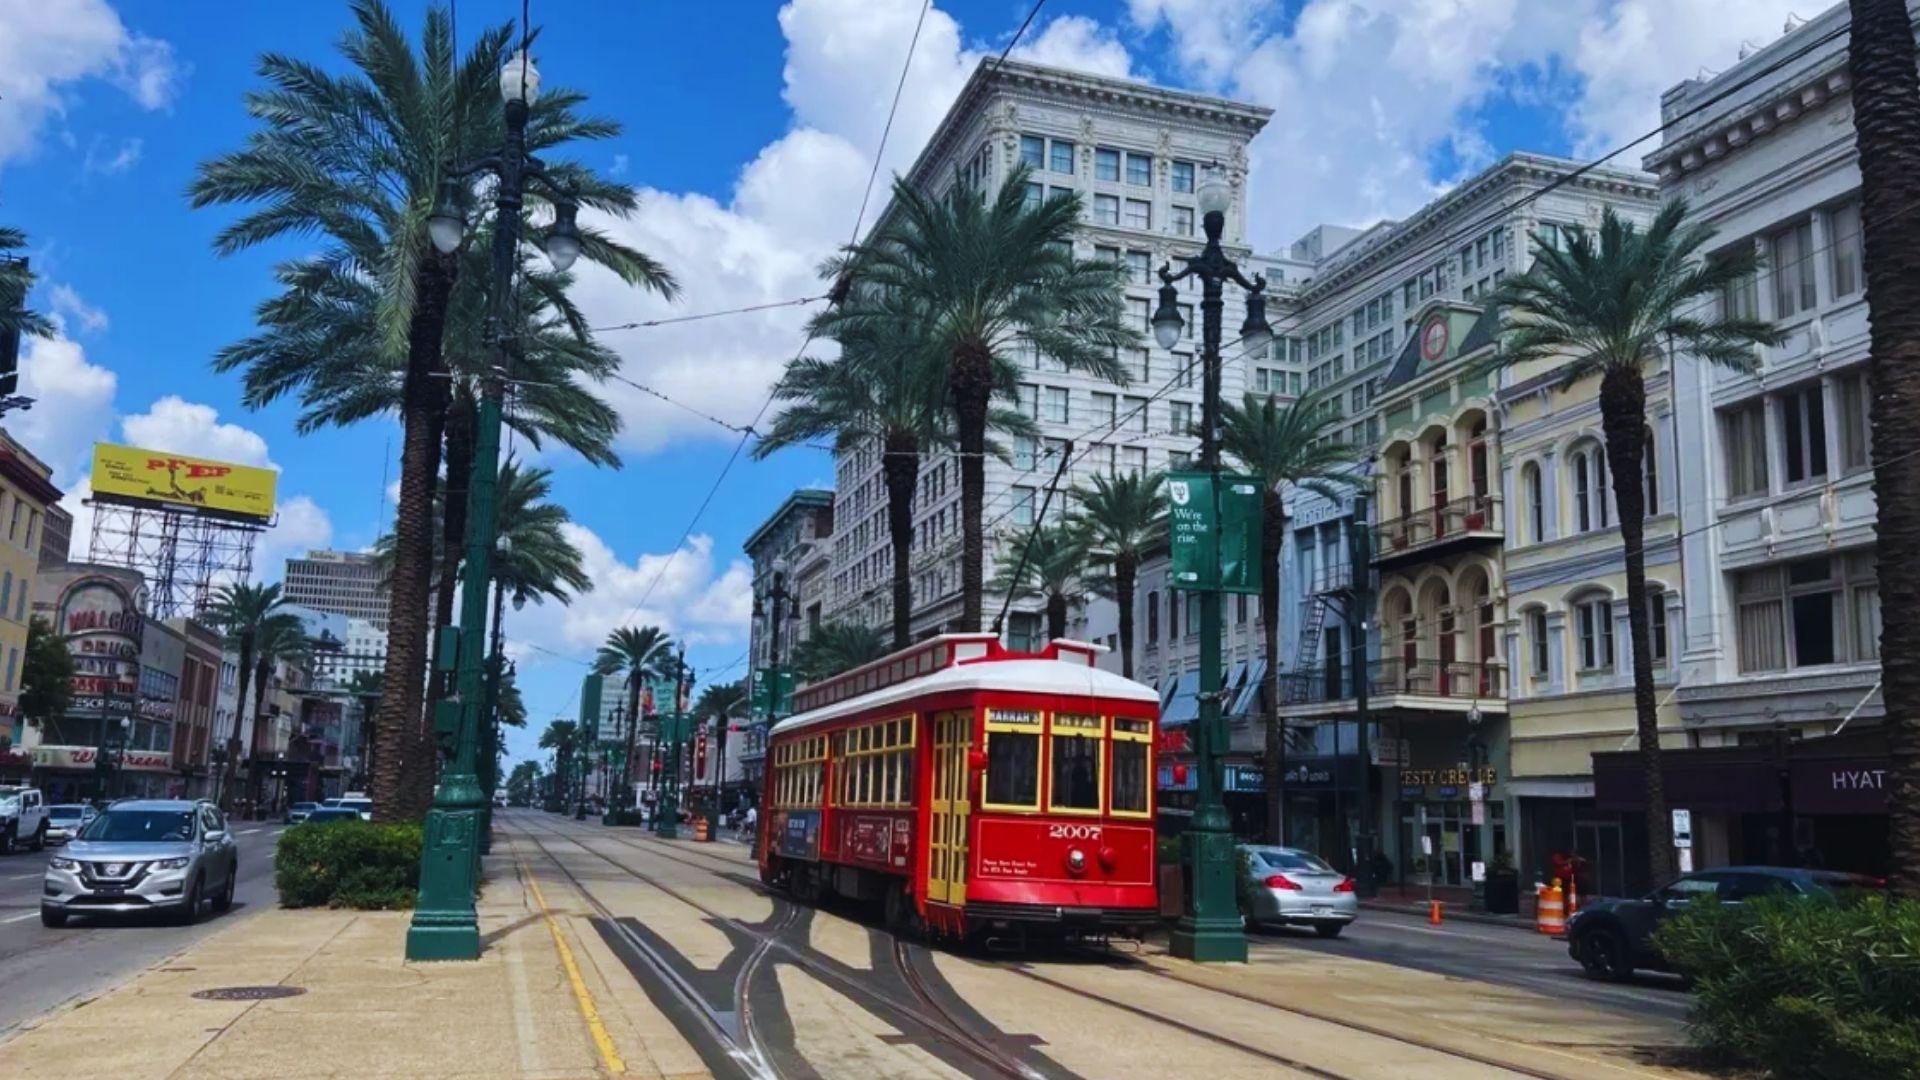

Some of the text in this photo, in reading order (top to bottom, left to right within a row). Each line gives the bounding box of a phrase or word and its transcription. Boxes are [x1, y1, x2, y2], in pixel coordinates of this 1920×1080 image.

[1173, 508, 1203, 520] We're
[1176, 521, 1208, 533] on the
[1440, 767, 1497, 784] CRELE
[1832, 770, 1888, 789] HYAT
[1049, 824, 1101, 840] 2007
